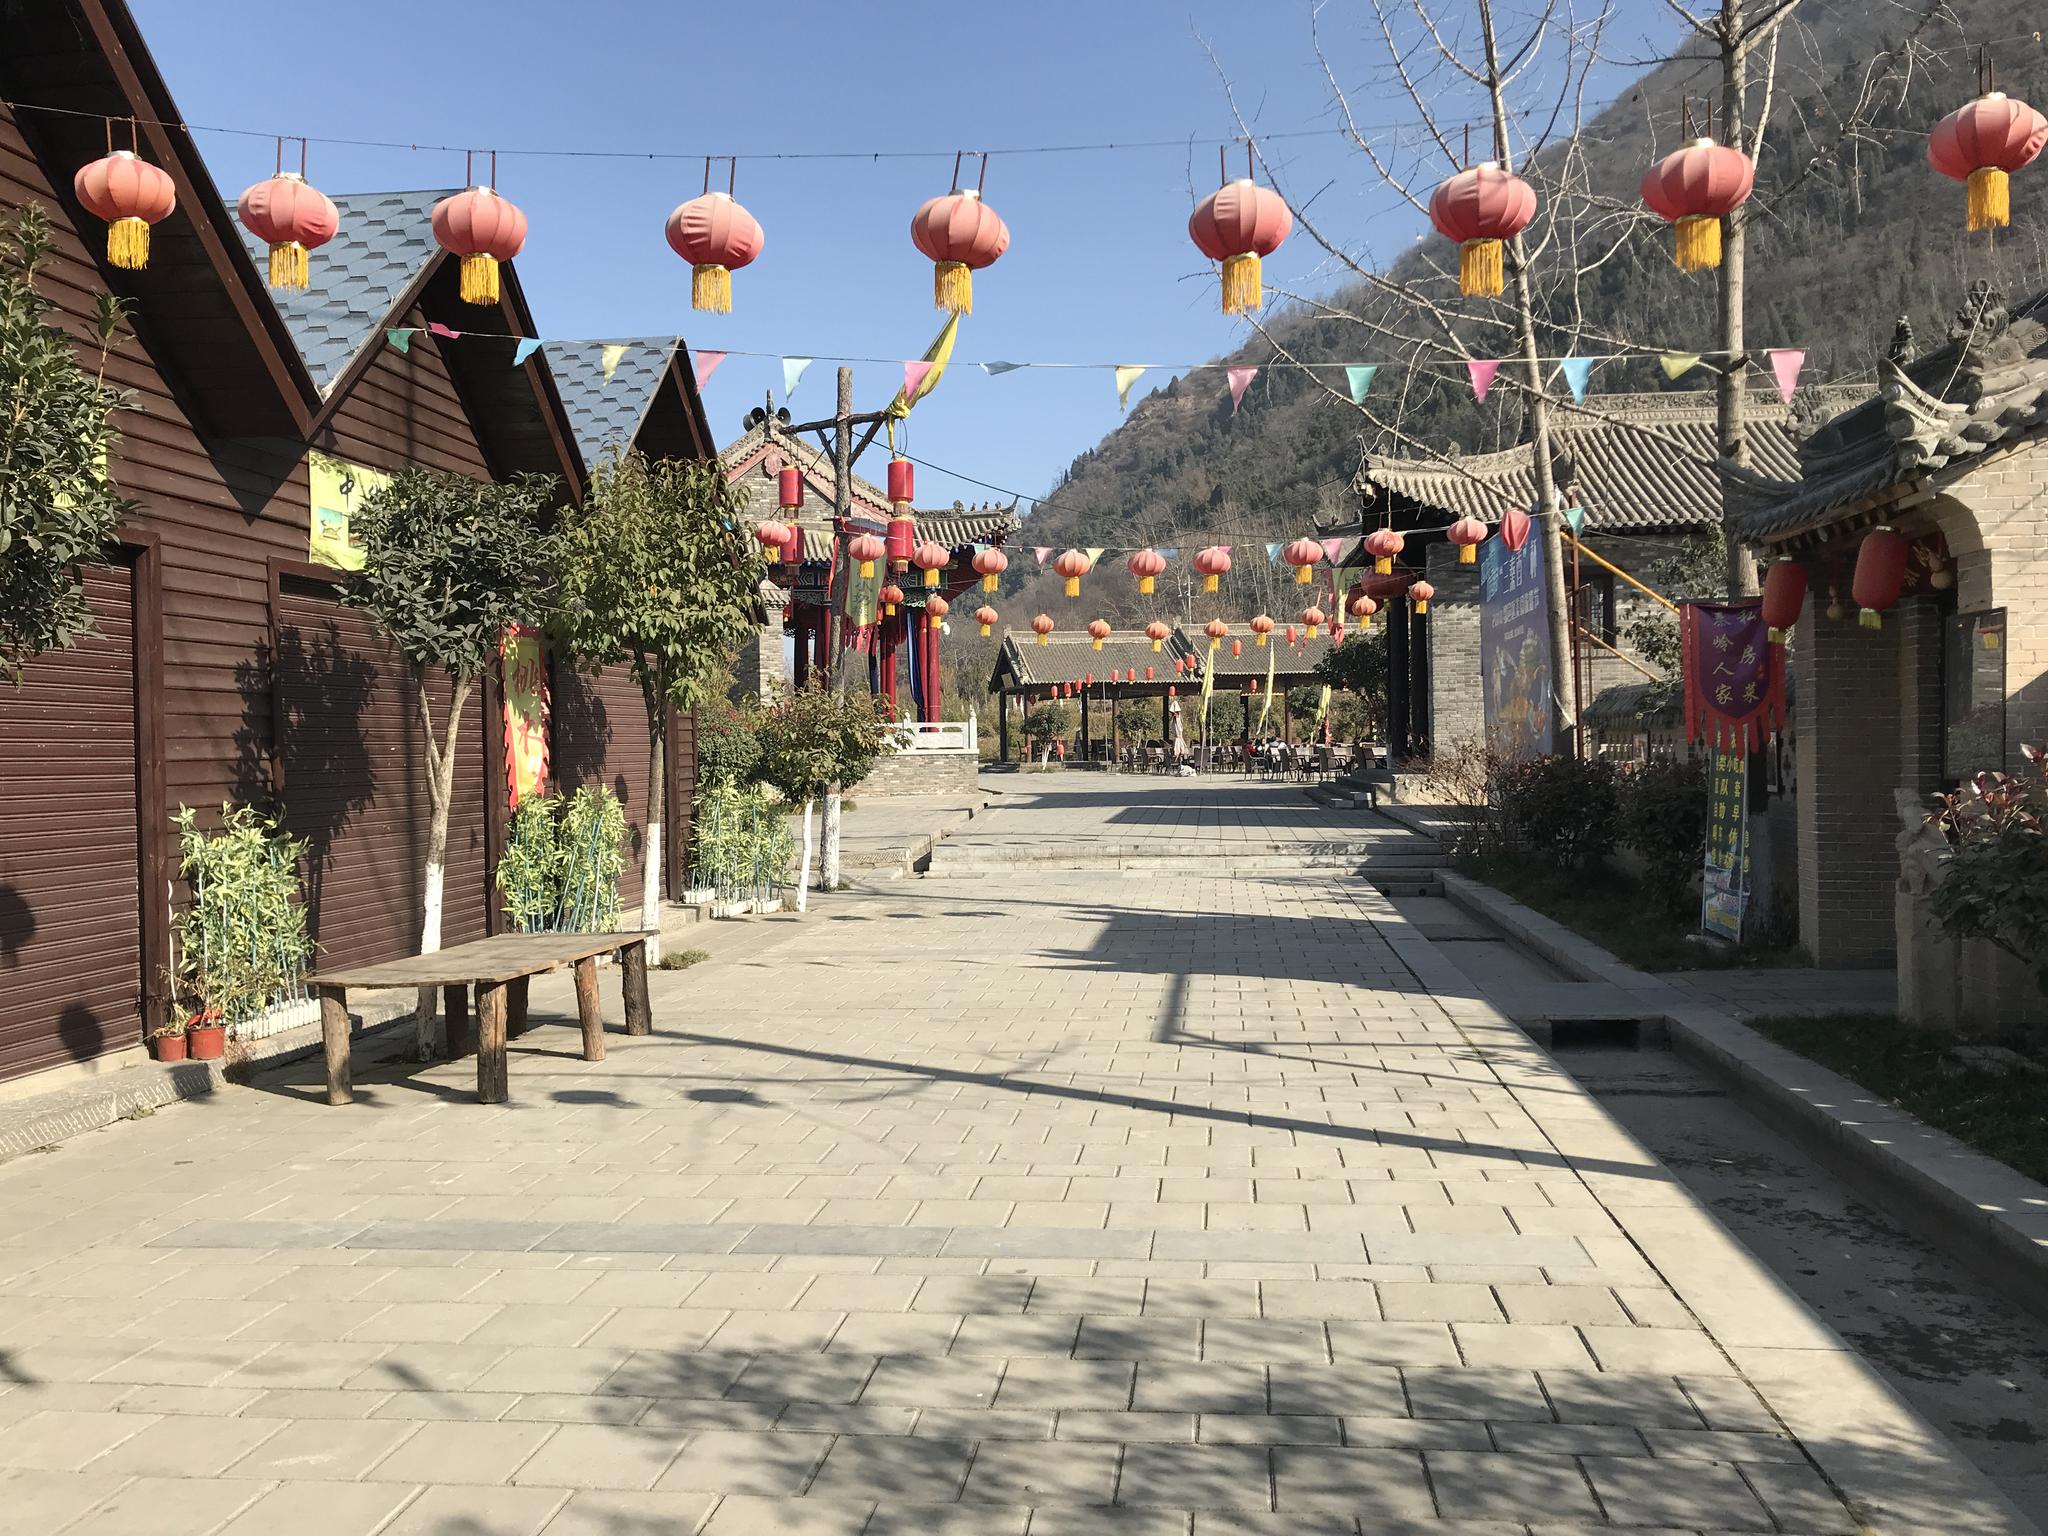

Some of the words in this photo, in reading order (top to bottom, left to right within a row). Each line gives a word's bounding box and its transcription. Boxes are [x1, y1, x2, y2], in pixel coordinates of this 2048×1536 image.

[1712, 611, 1735, 705] 秦岭人家
[1736, 609, 1760, 704] 私房菜
